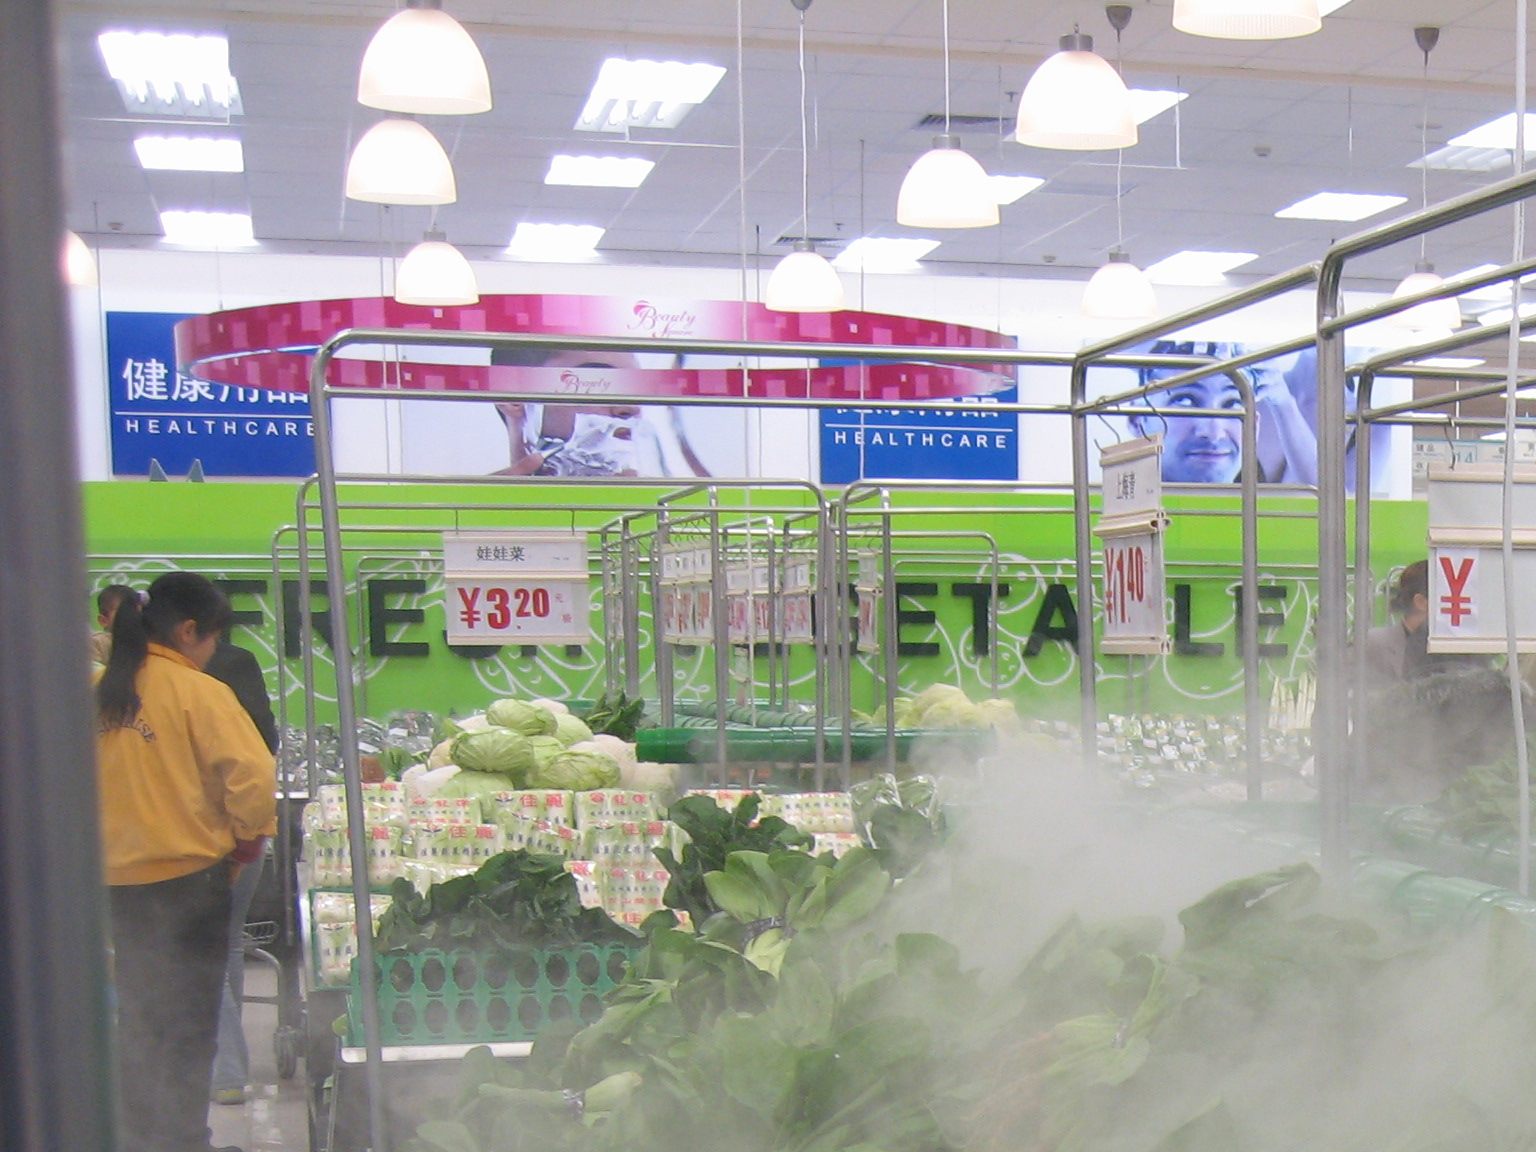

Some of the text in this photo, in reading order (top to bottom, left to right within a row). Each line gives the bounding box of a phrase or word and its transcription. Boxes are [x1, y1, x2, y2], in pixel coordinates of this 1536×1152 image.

[126, 419, 315, 436] HEALTHCARE
[834, 431, 1007, 449] HEALTHCARE
[476, 545, 526, 562] 娃娃菜
[457, 587, 551, 630] ¥3.20
